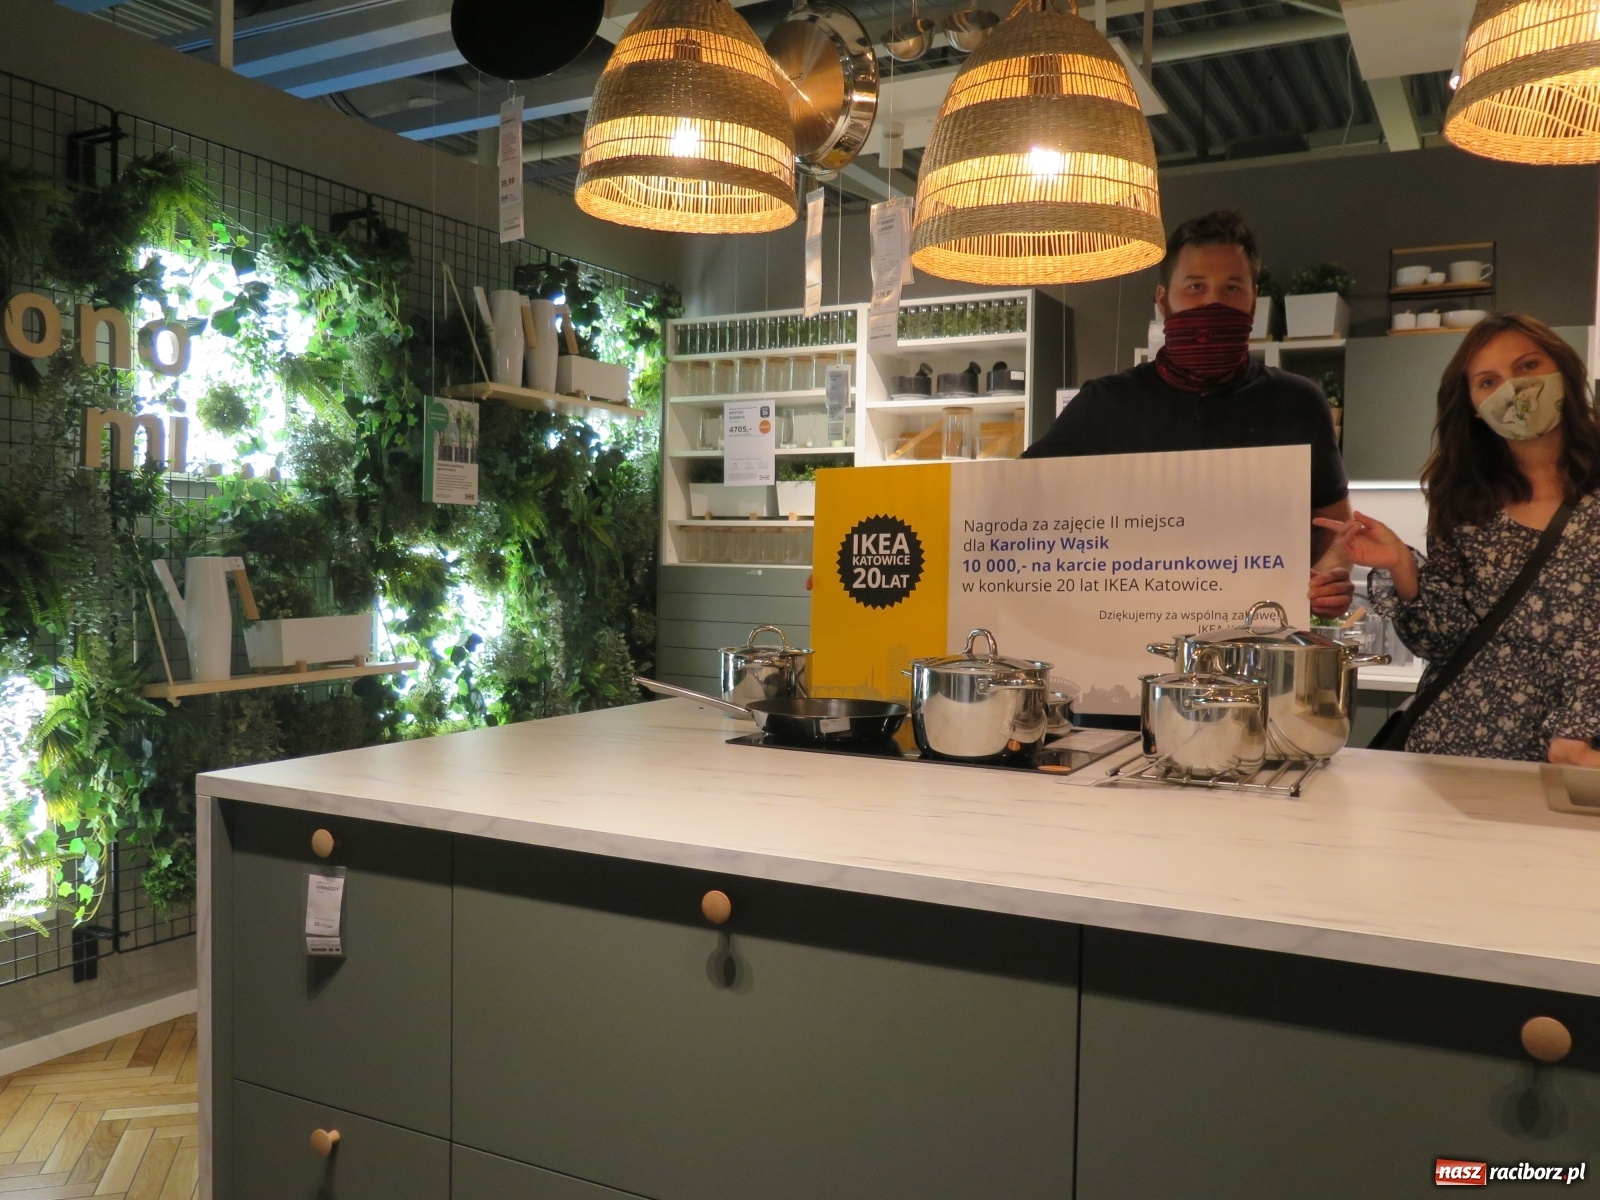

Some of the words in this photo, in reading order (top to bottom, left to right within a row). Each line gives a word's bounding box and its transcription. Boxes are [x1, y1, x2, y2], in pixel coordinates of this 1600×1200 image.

[964, 518, 1028, 534] Nagroda
[1032, 520, 1049, 531] za
[1053, 516, 1105, 533] zajęcie
[1110, 516, 1119, 529] II
[1124, 514, 1185, 531] miejsca
[853, 533, 910, 555] IKEA
[963, 538, 985, 553] dla
[990, 537, 1055, 554] Karoliny
[1060, 535, 1109, 554] Wąsik
[853, 555, 910, 566] KATOWICE
[963, 558, 981, 573] 10
[986, 558, 1027, 575] 000,-
[1031, 560, 1053, 572] na
[1057, 557, 1107, 572] karcie
[1112, 555, 1239, 575] podarunkowej
[1244, 555, 1284, 569] IKEA
[962, 581, 974, 592] w
[978, 578, 1052, 592] konkursie
[1057, 578, 1075, 592] 20
[1080, 577, 1099, 591] lat
[1104, 577, 1139, 592] IKEA
[1145, 577, 1223, 591] Katowice.
[1100, 610, 1163, 622] Dziękujemy
[1166, 612, 1177, 620] za
[1181, 610, 1228, 621] wspólną
